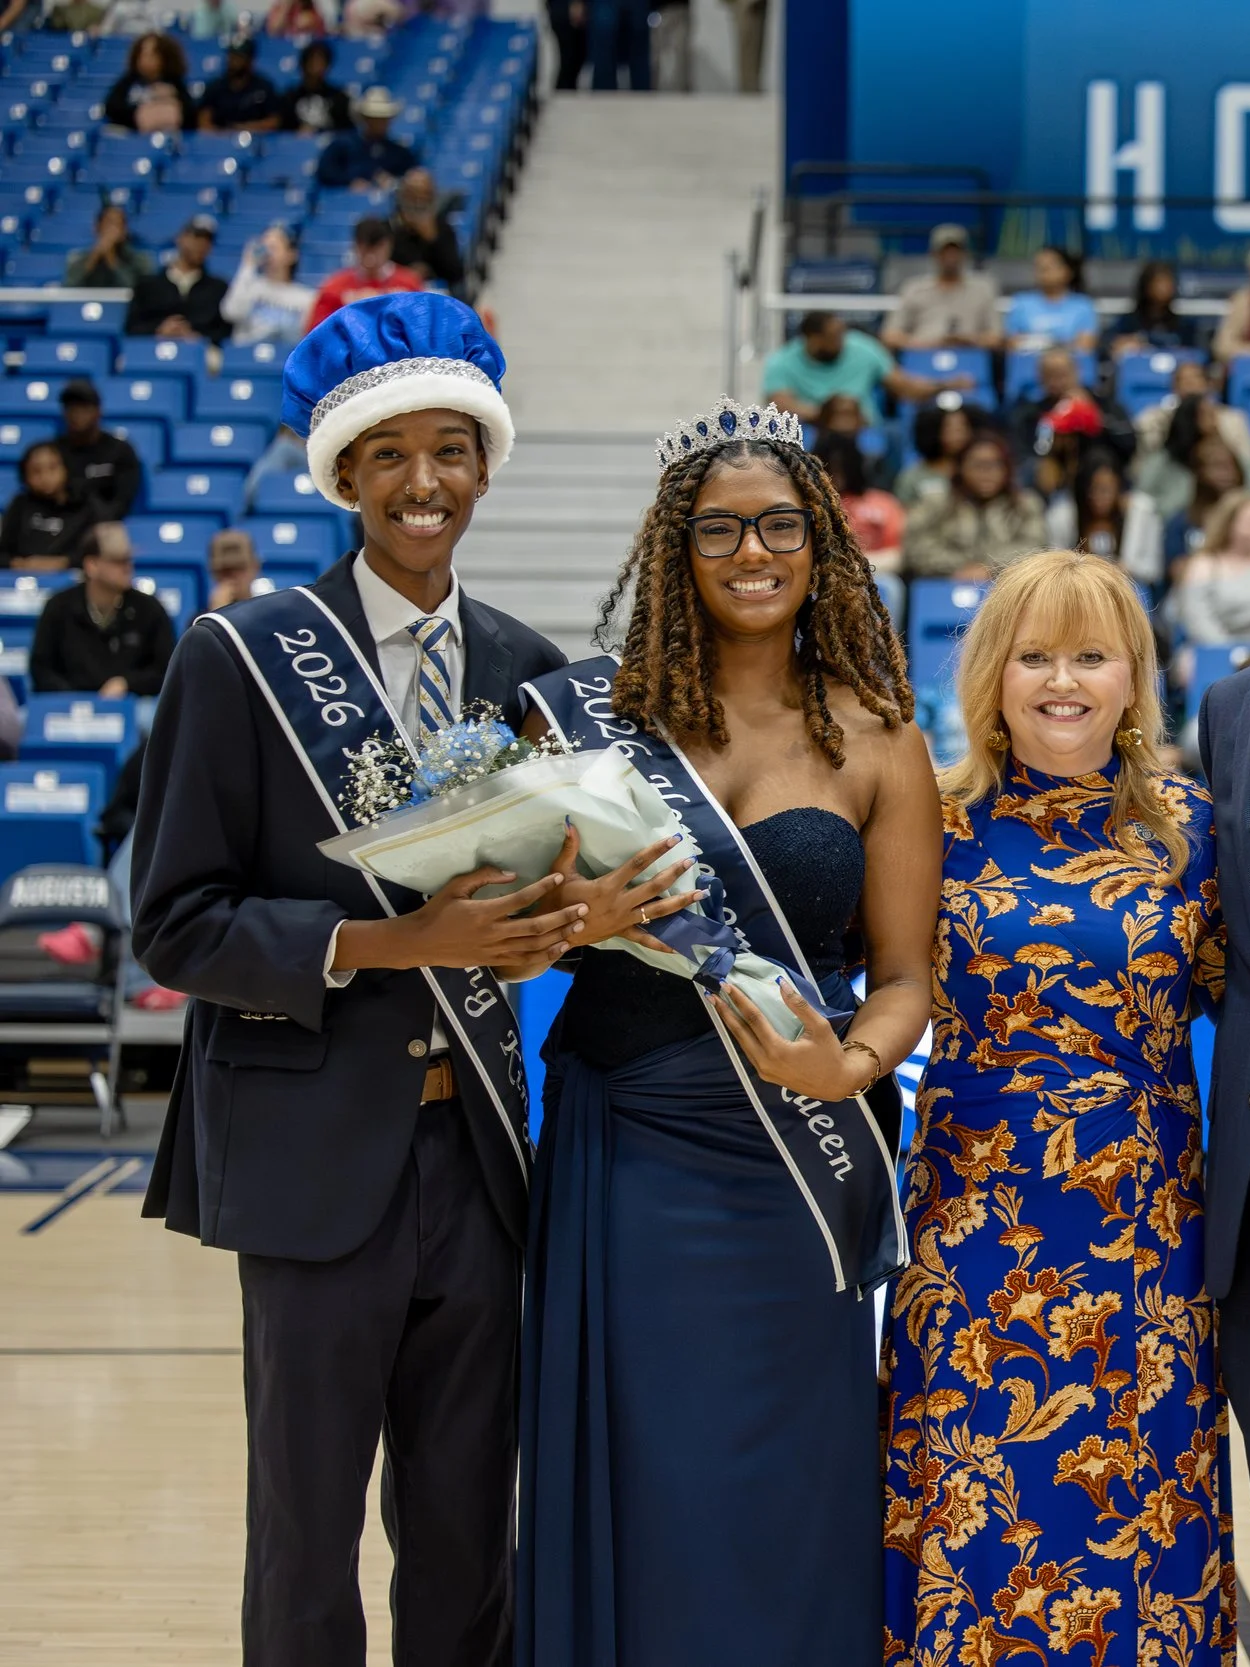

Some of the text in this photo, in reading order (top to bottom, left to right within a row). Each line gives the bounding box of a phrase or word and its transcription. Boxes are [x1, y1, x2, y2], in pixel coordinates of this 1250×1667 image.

[273, 628, 366, 727] 2026
[567, 676, 653, 760] 2026
[10, 875, 110, 908] AUGUSTA
[780, 1085, 855, 1183] ueen
